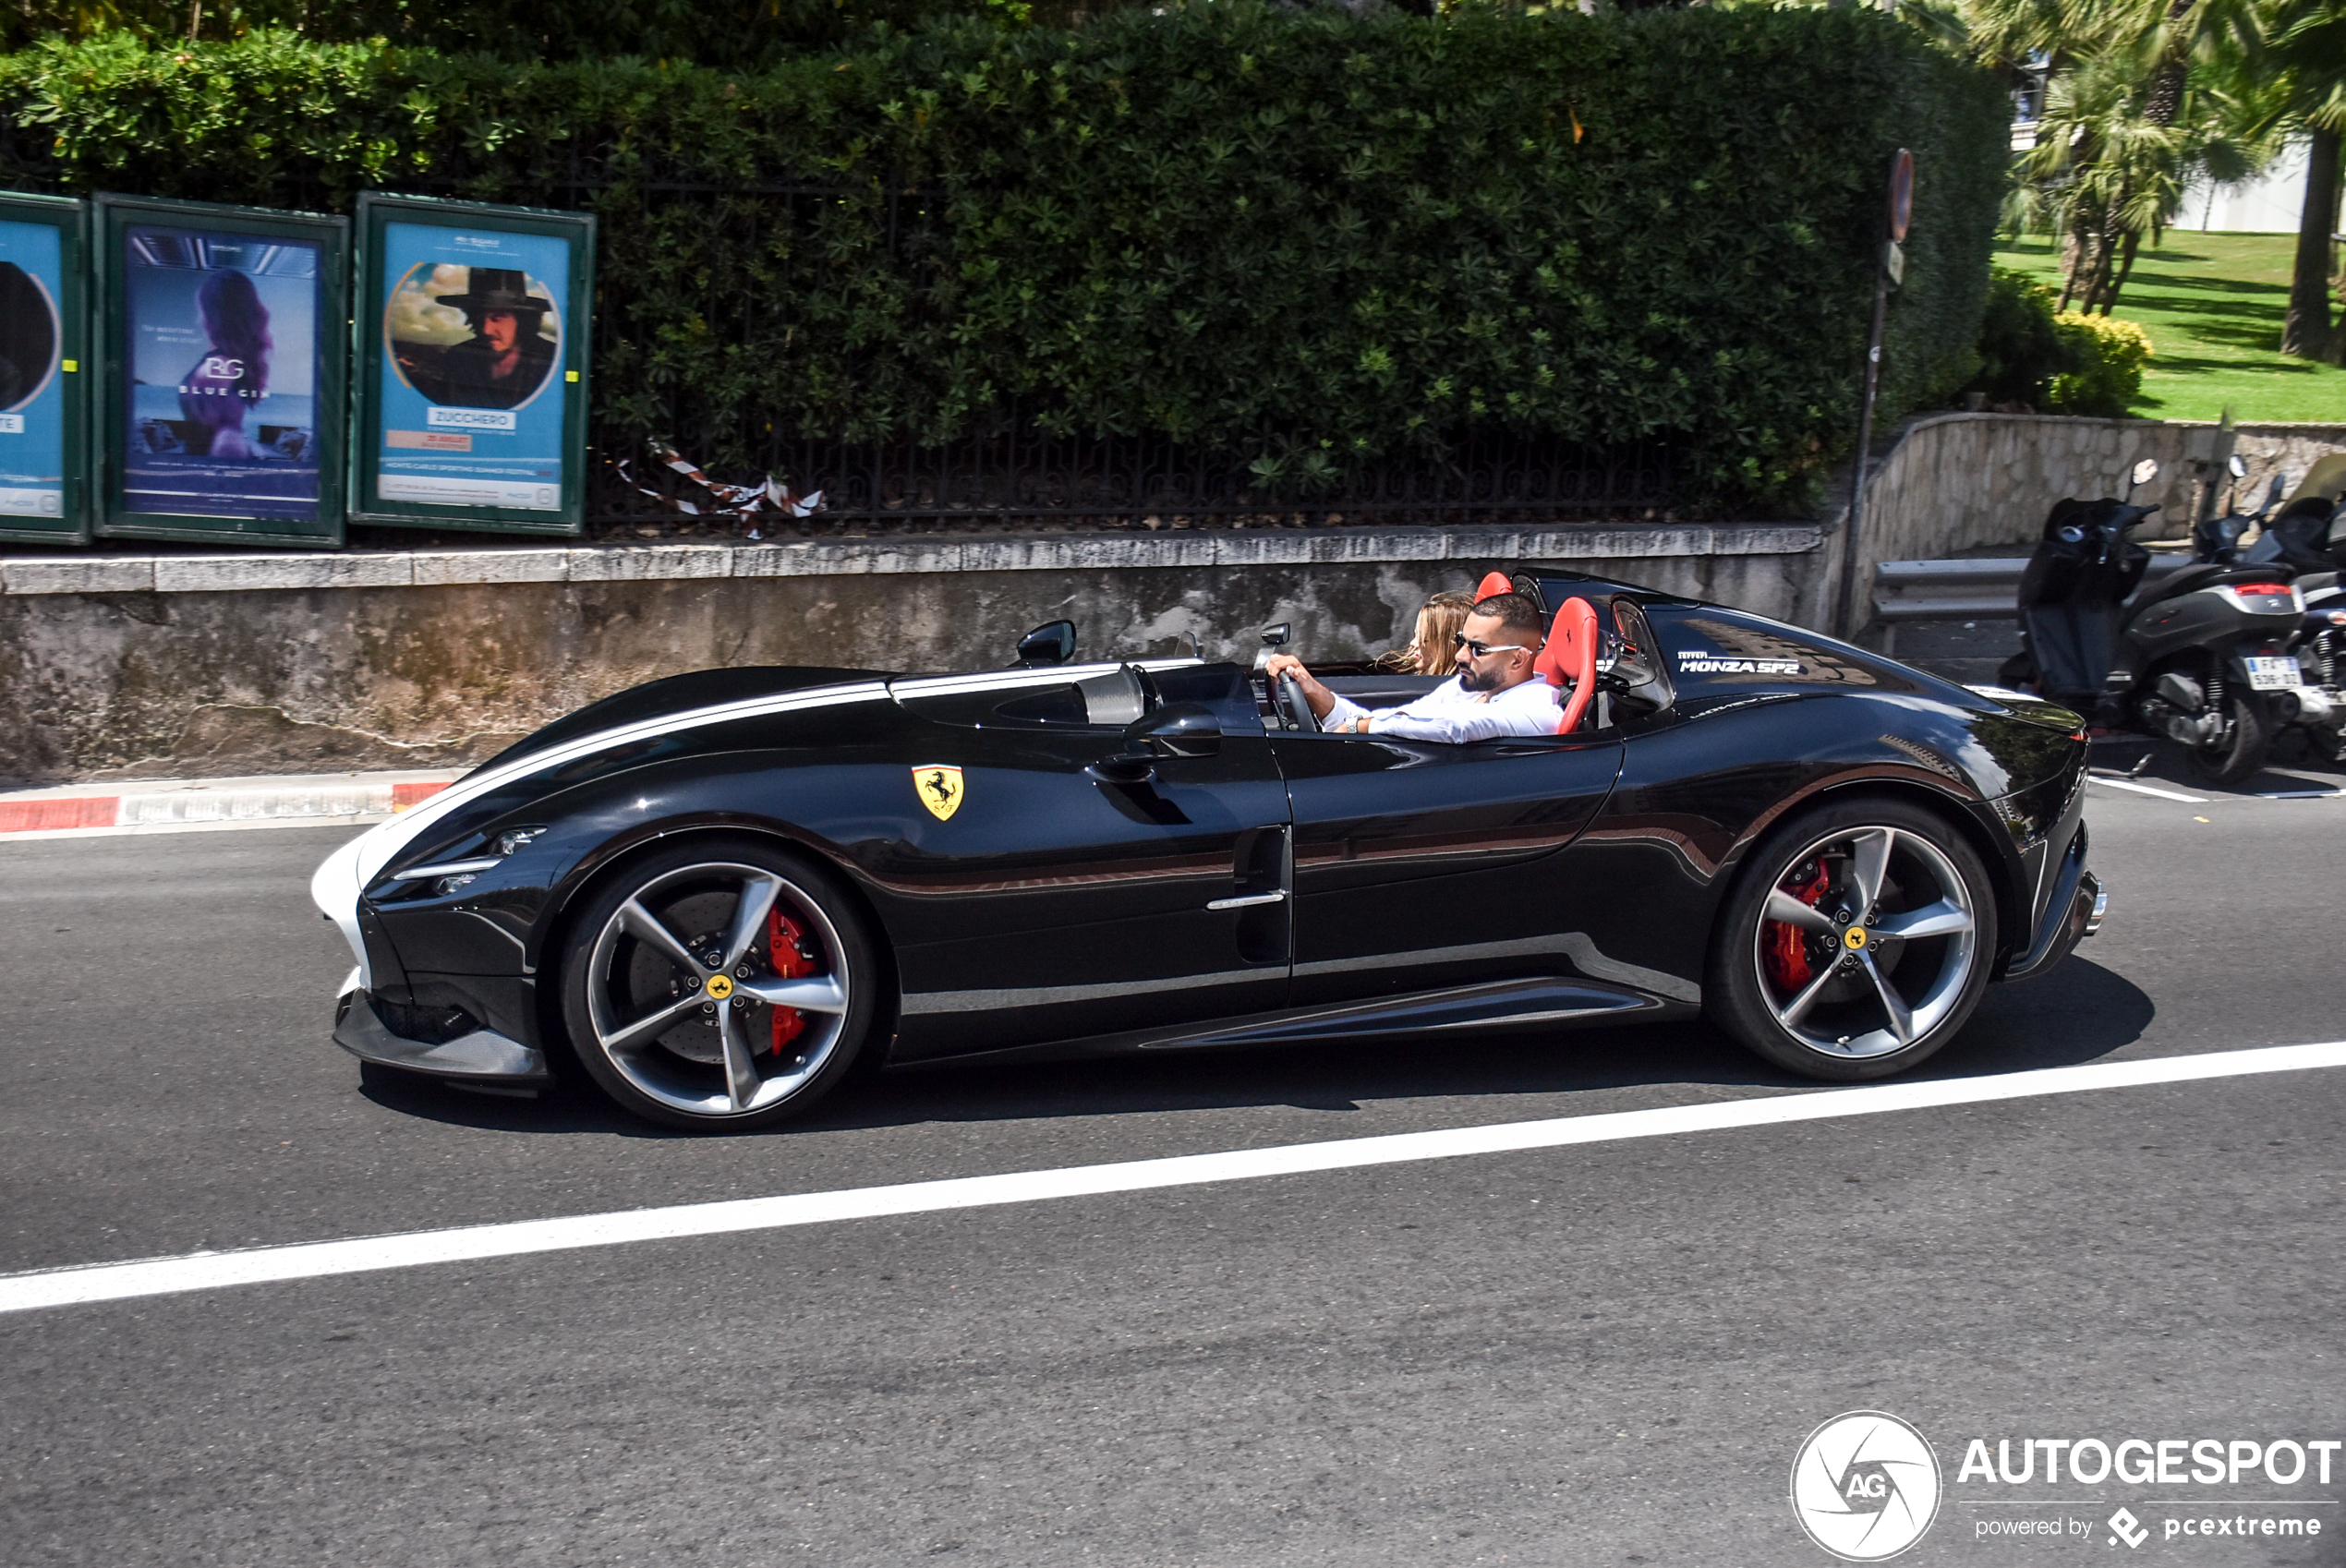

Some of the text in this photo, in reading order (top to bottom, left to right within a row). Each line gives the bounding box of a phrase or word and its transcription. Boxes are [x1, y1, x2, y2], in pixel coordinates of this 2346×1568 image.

[178, 385, 228, 395] BLUE
[435, 411, 508, 425] ZUCCHERO
[1679, 661, 1800, 675] MONZA SP2
